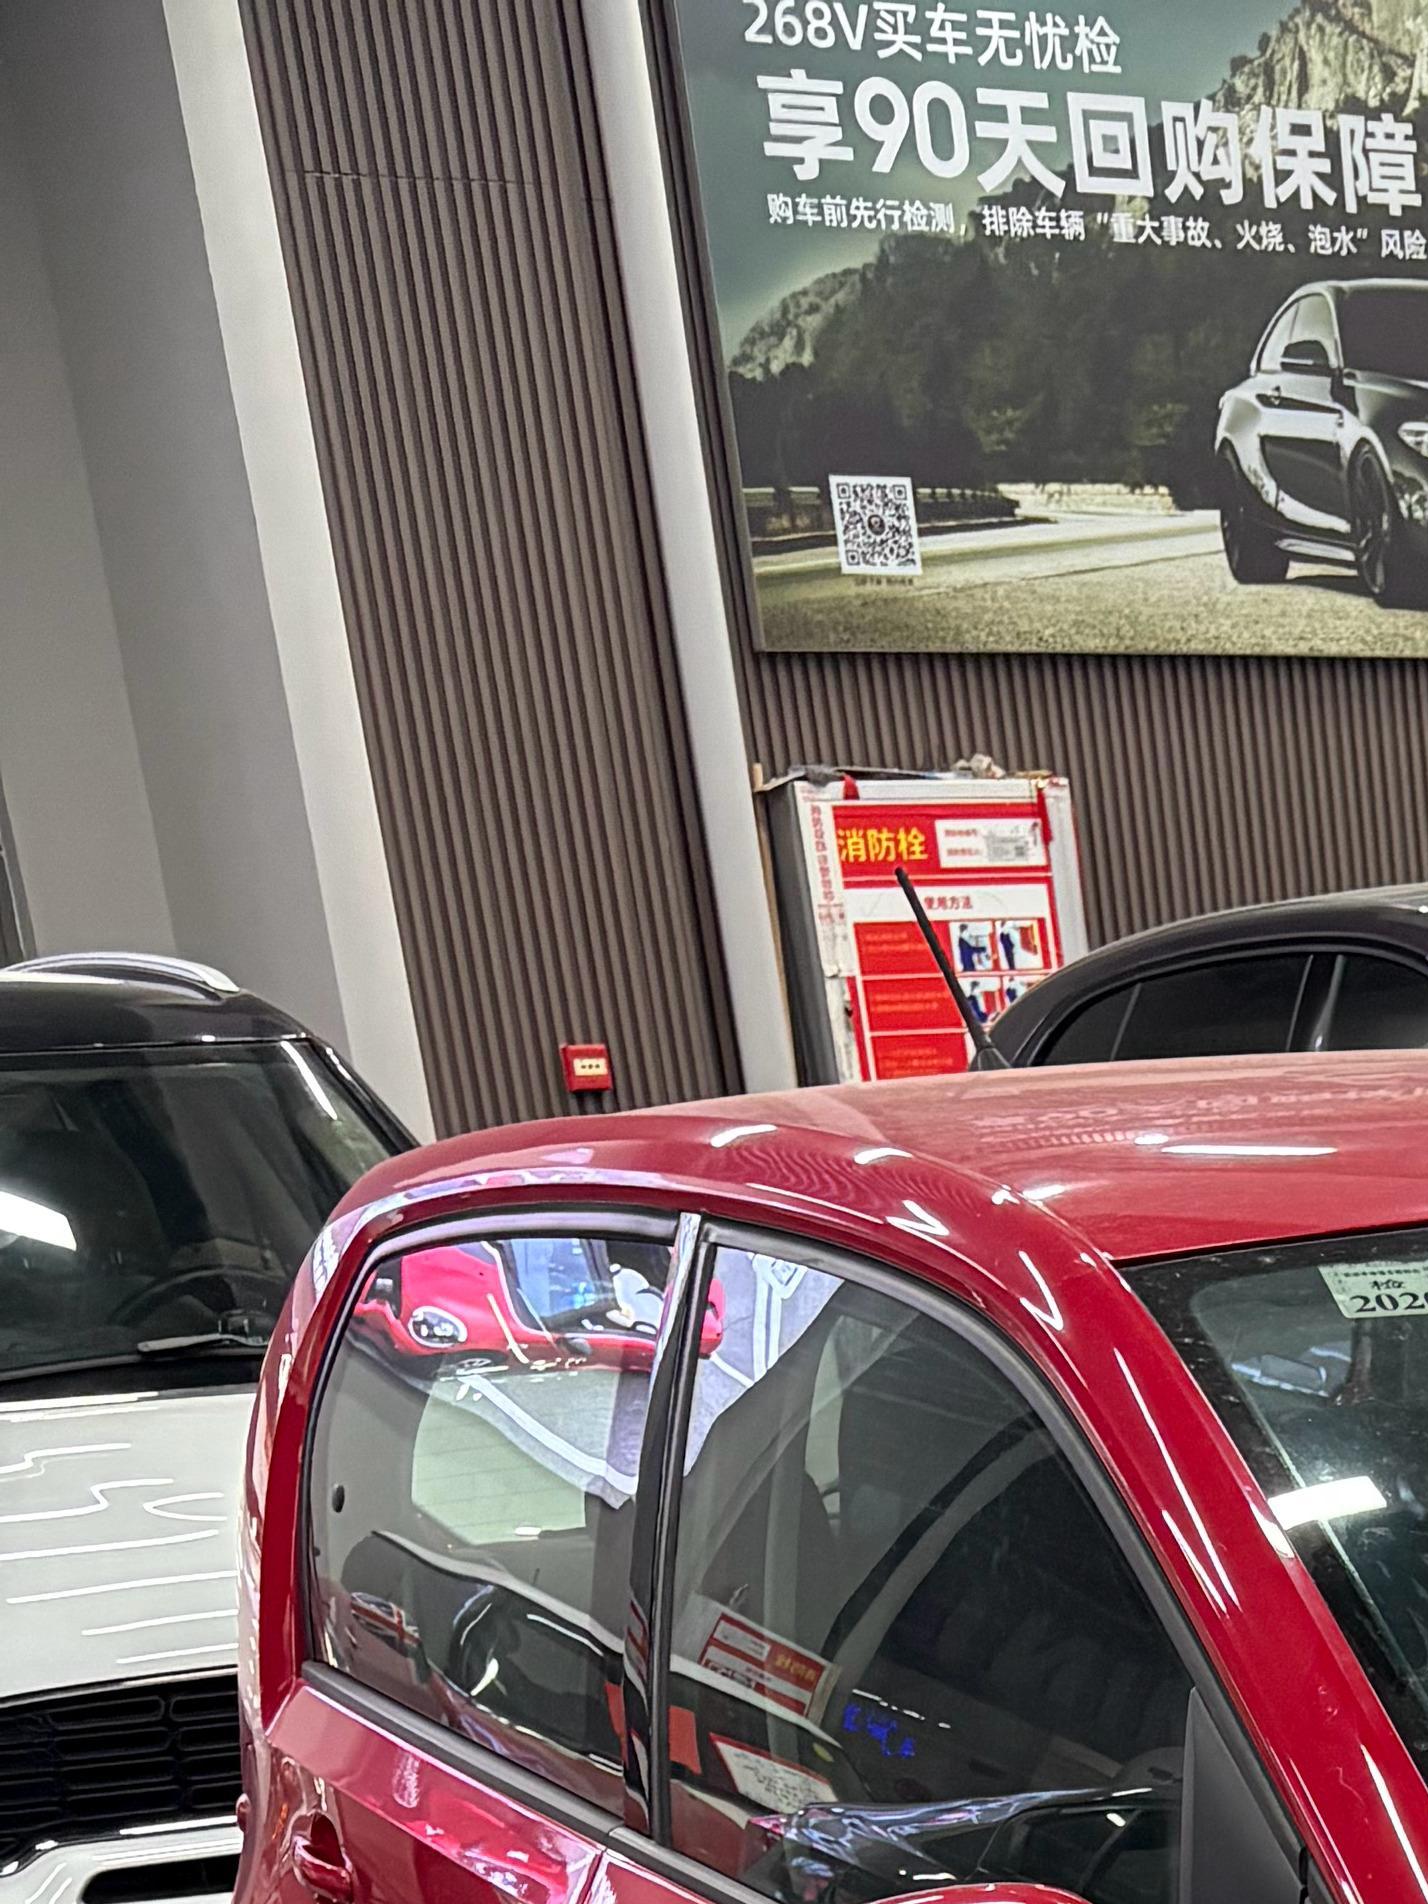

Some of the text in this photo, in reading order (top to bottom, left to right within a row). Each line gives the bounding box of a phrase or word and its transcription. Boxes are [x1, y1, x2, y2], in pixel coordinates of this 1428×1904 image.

[743, 0, 1121, 74] 268V买车无忧检
[756, 68, 1422, 217] 享90天回购保障
[837, 826, 929, 863] 消防栓
